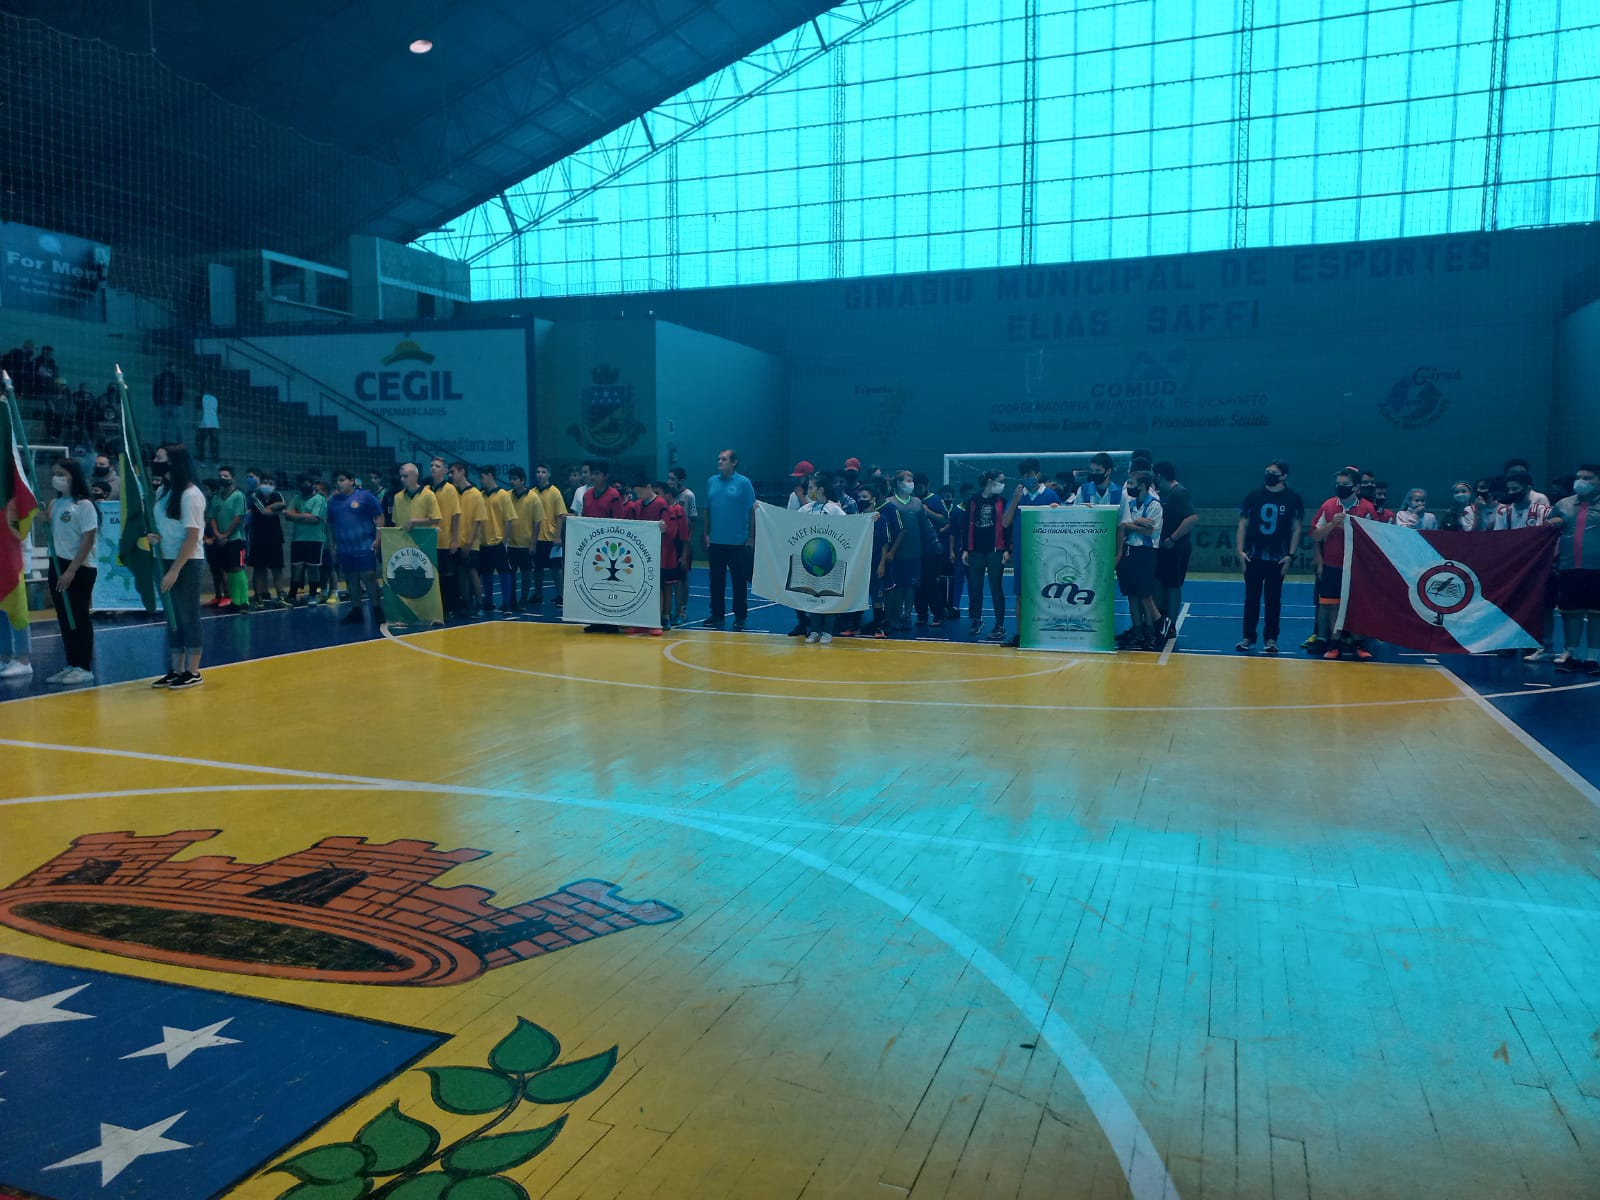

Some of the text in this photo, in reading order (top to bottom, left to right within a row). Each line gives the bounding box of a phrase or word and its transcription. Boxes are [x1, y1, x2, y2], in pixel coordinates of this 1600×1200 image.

[6, 250, 46, 271] For
[998, 261, 1195, 302] MUNICIPAL
[1220, 255, 1268, 288] DE
[1293, 239, 1492, 284] ESPORTES
[1007, 299, 1260, 342] ELIAS SAFFI
[354, 370, 464, 402] CEGIL
[576, 538, 589, 557] EMEF
[606, 525, 625, 535] JOÃO
[626, 531, 653, 563] BISOGNIN
